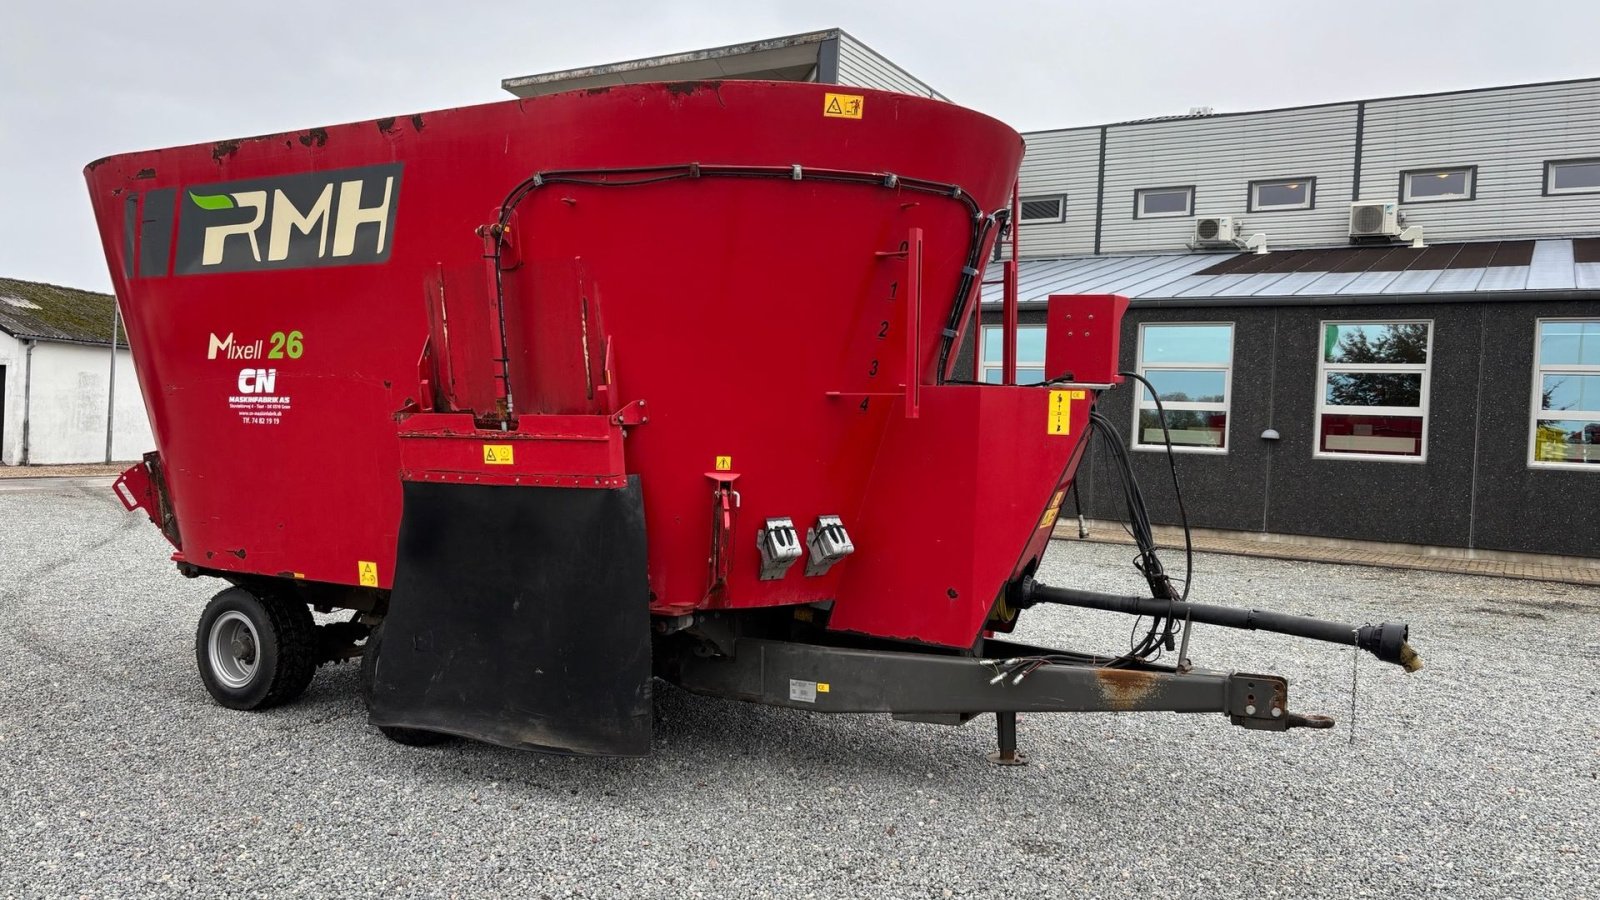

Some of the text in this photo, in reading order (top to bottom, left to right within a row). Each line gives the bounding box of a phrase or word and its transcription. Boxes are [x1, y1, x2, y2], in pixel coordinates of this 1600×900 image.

[189, 176, 394, 265] RMH
[890, 281, 898, 298] 1
[878, 320, 889, 338] 2
[208, 331, 304, 359] Mixell 26
[869, 359, 878, 377] 3
[238, 368, 276, 394] CN
[860, 397, 869, 411] 4
